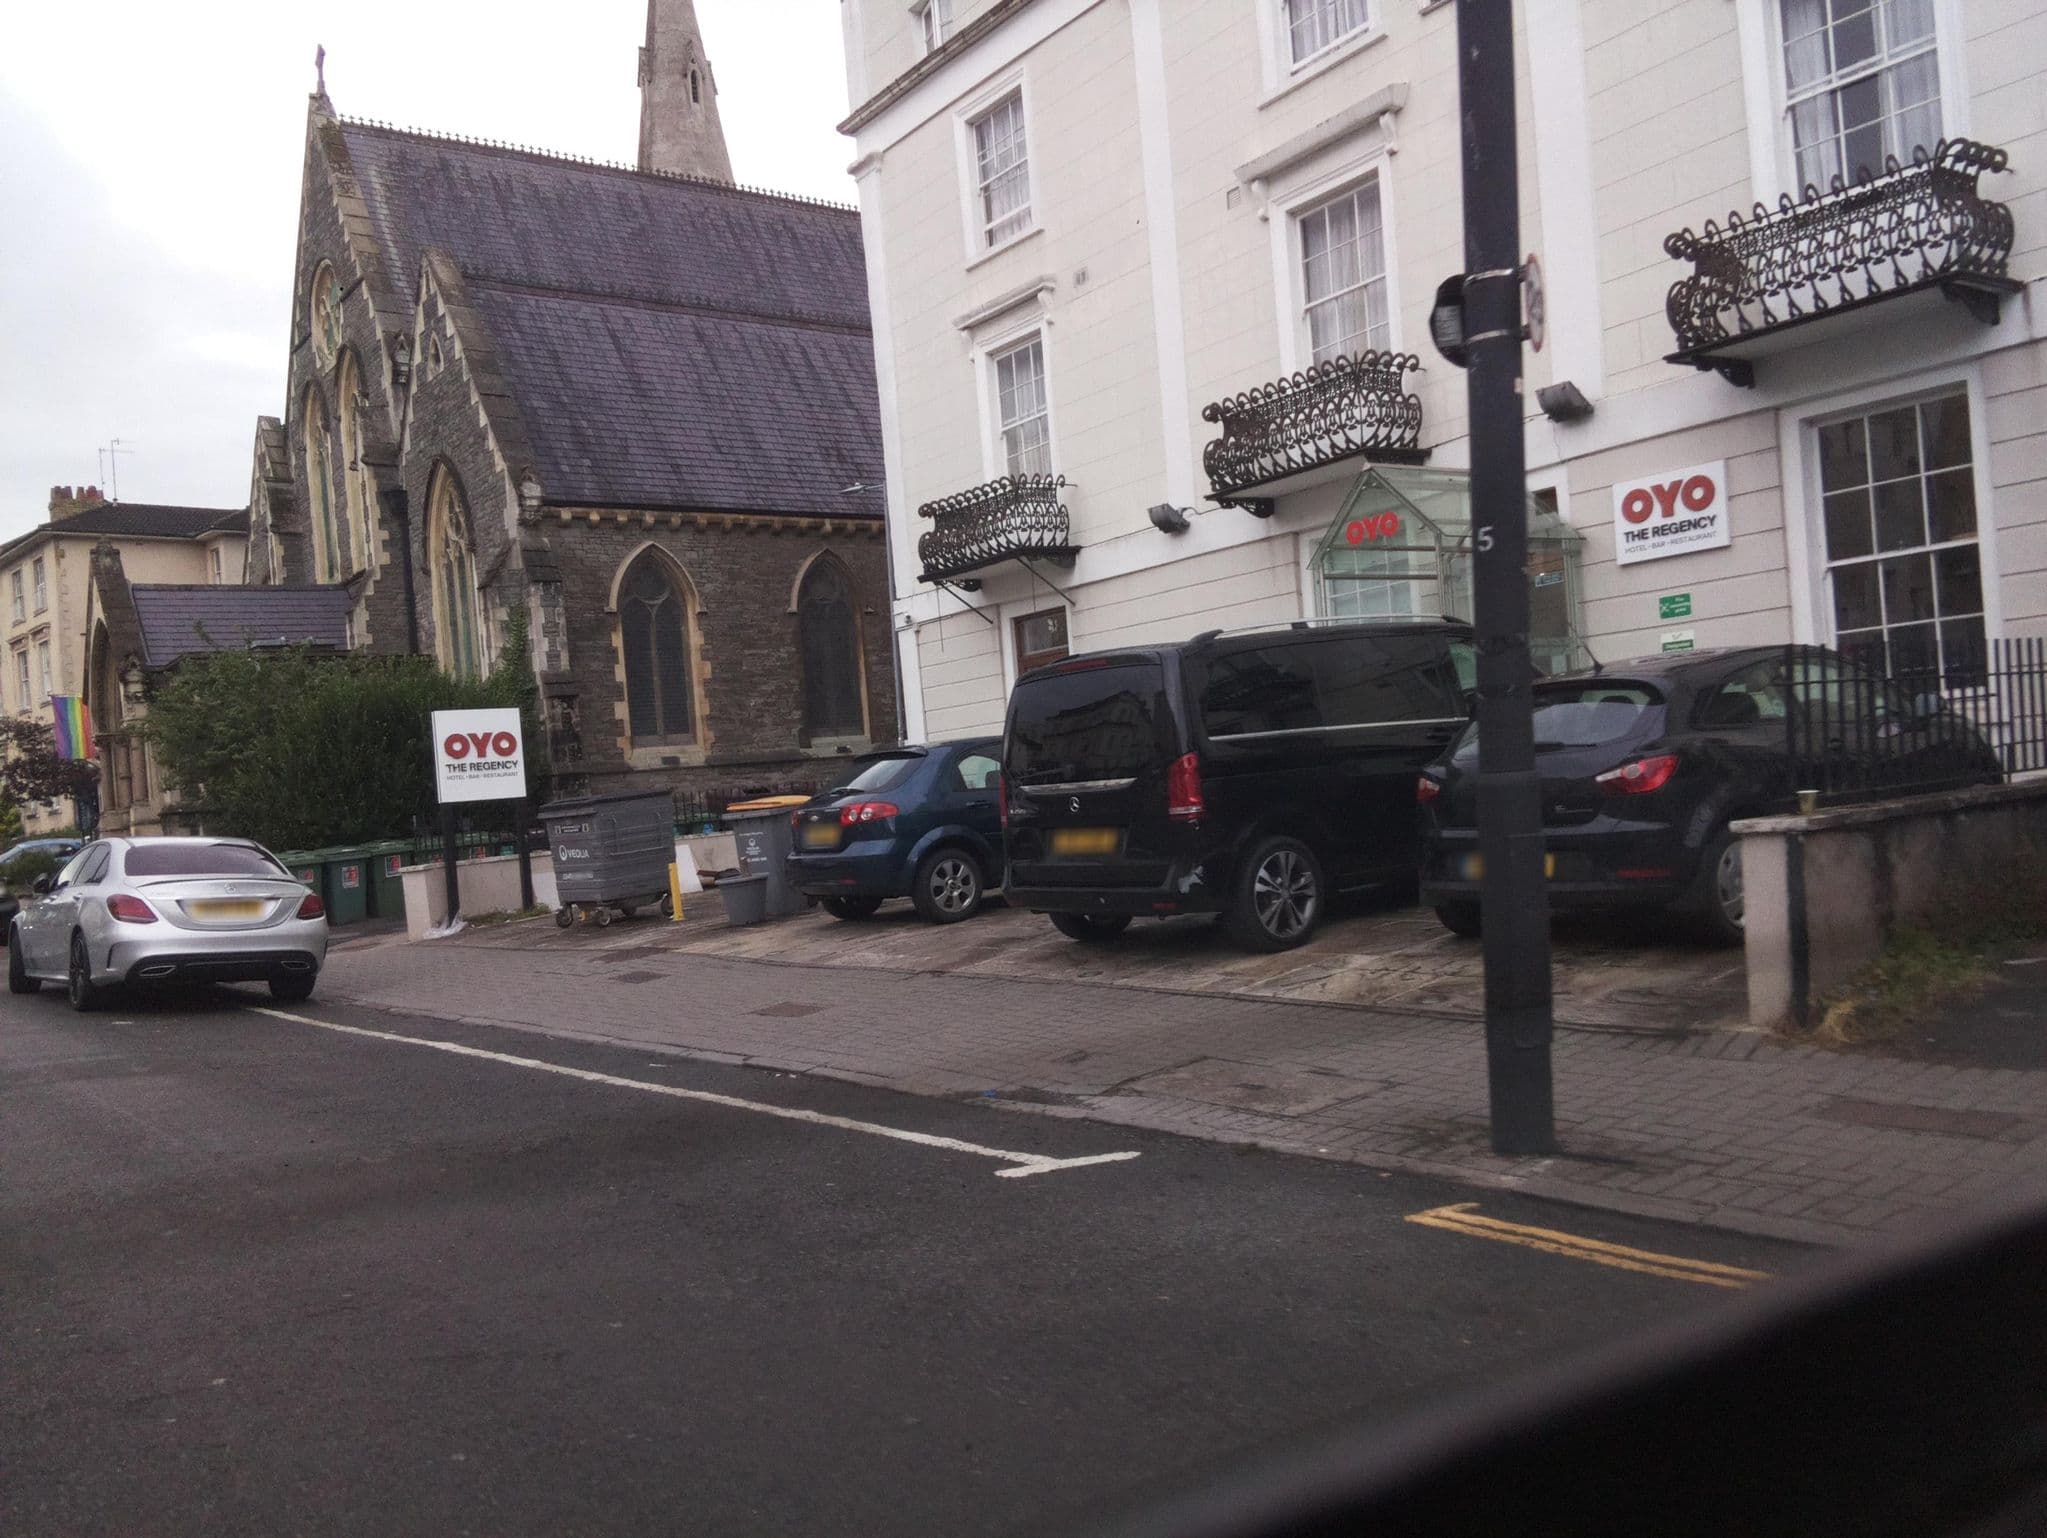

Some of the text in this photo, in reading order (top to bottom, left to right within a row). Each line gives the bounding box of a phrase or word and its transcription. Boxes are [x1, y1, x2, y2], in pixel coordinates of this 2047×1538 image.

[1621, 475, 1715, 524] OYO
[1346, 511, 1398, 545] OYO
[1478, 526, 1494, 552] 5
[1624, 515, 1717, 543] THE REGENCY
[1625, 530, 1717, 554] HOTEL BAR RESTAURANT
[444, 731, 517, 759] OYO
[445, 760, 518, 773] THE REGENCY
